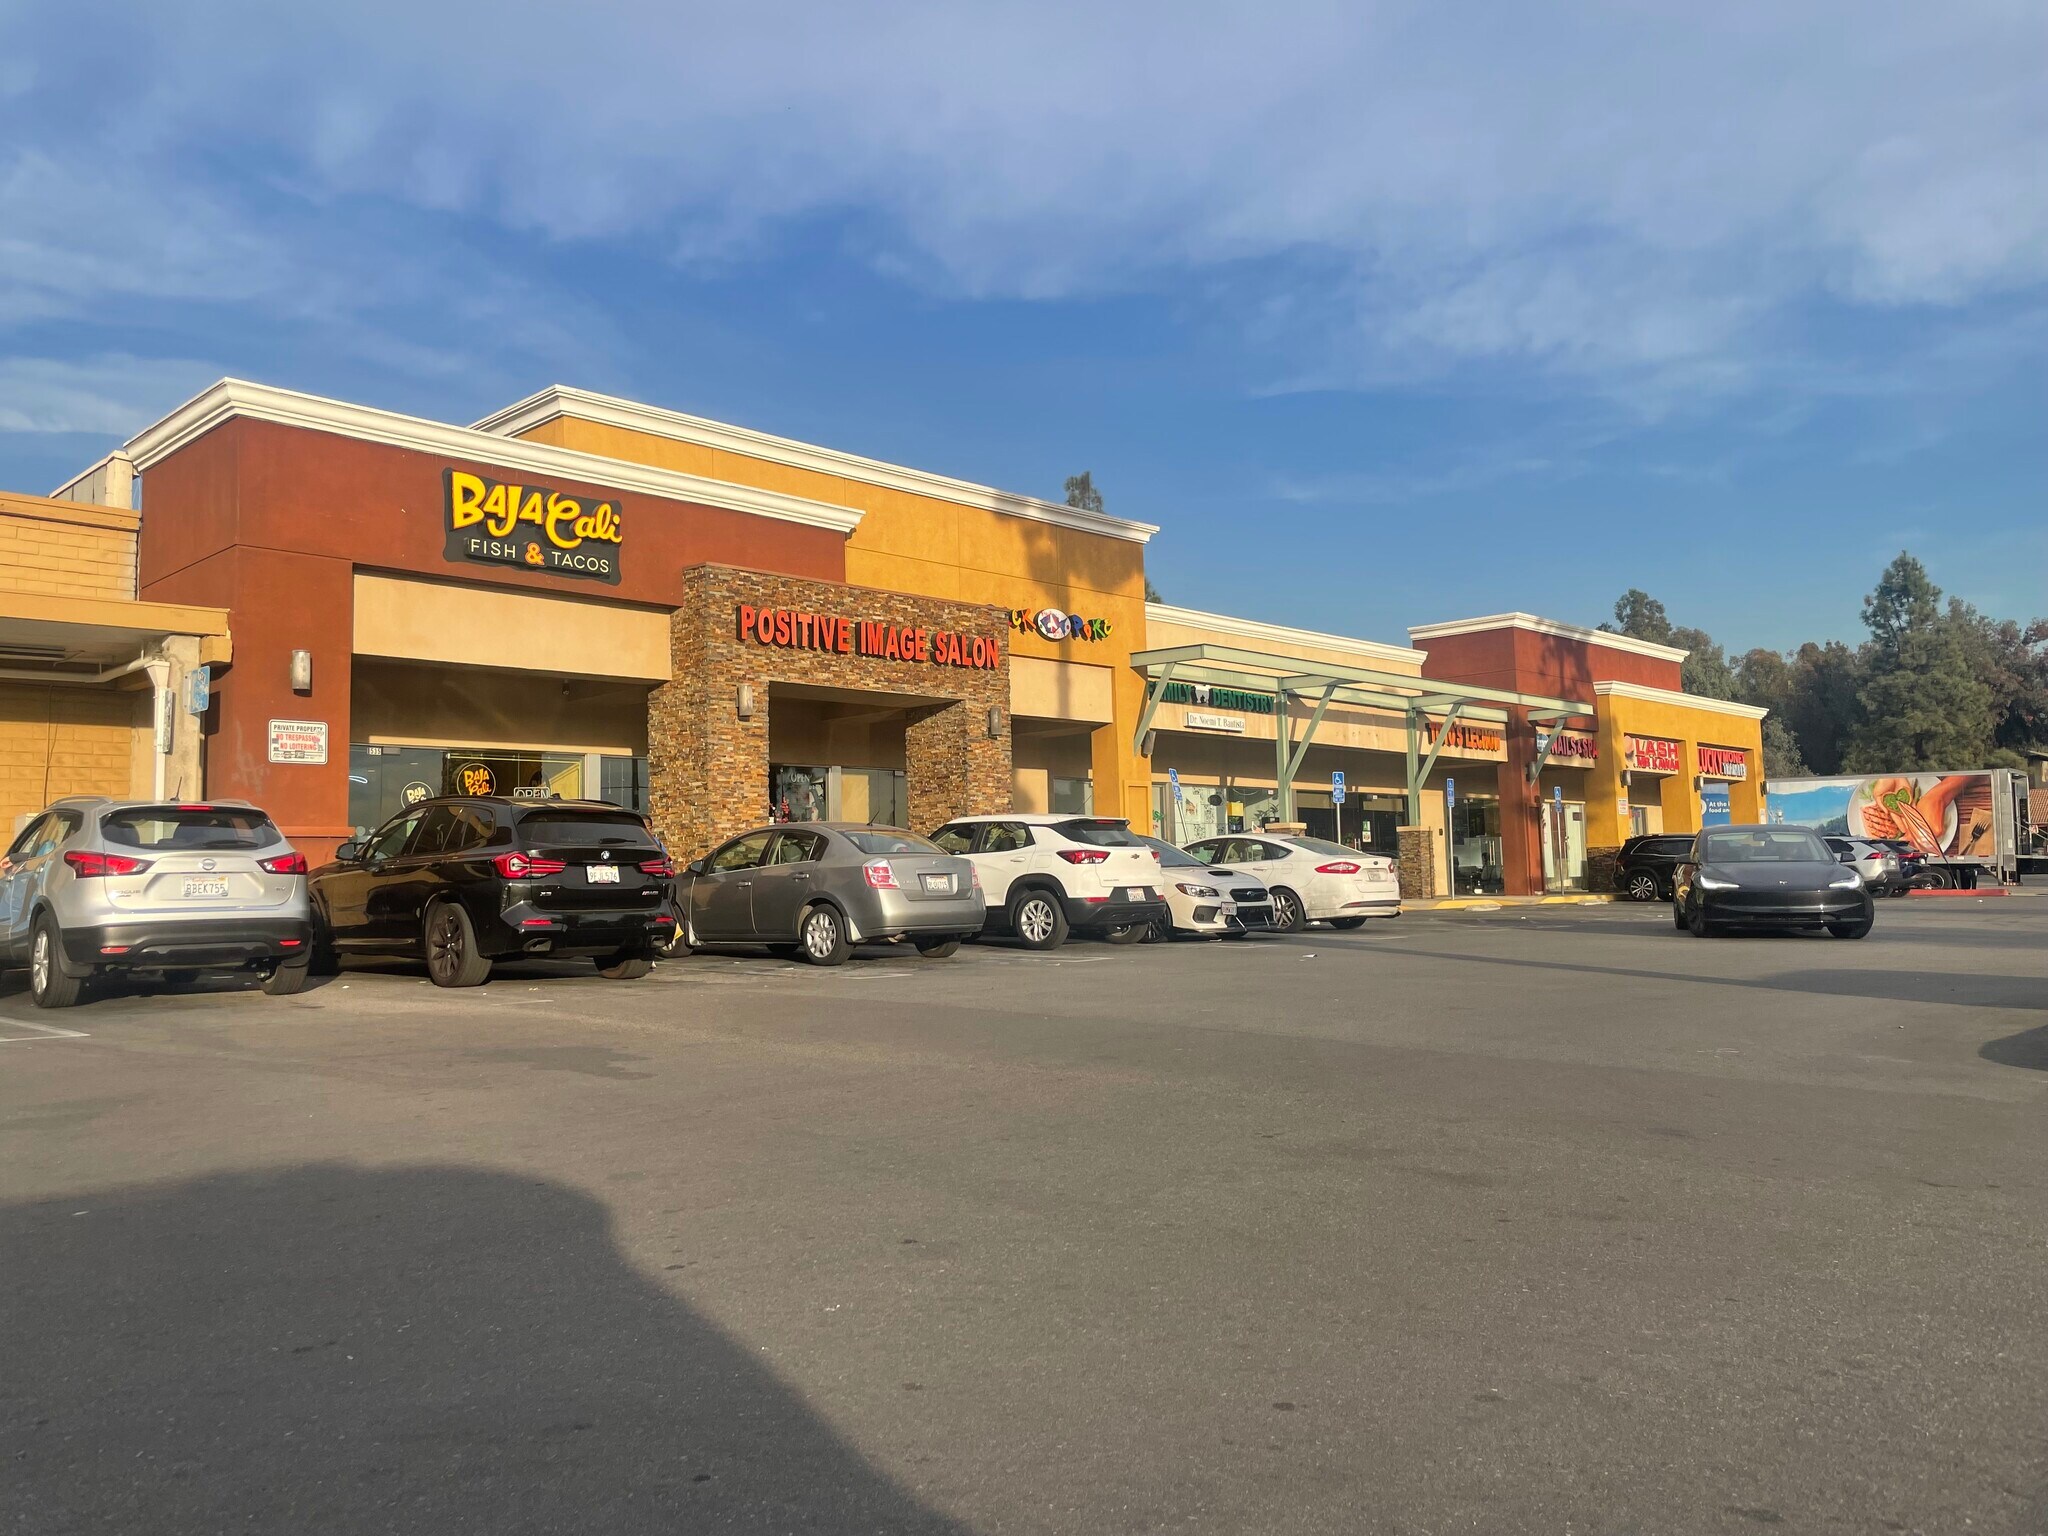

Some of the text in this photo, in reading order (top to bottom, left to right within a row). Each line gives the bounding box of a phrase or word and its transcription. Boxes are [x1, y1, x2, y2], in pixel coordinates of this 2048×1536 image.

[451, 471, 622, 549] BAJA Cali
[470, 538, 610, 573] FISH & TACOS
[738, 604, 999, 669] POSITIVE IMAGE SALON
[1148, 681, 1275, 713] FMILY DENTISTRY
[1635, 737, 1679, 758] LASH
[1699, 748, 1723, 774] LUCKY
[1722, 751, 1745, 764] MONEY
[464, 768, 490, 787] BAJA
